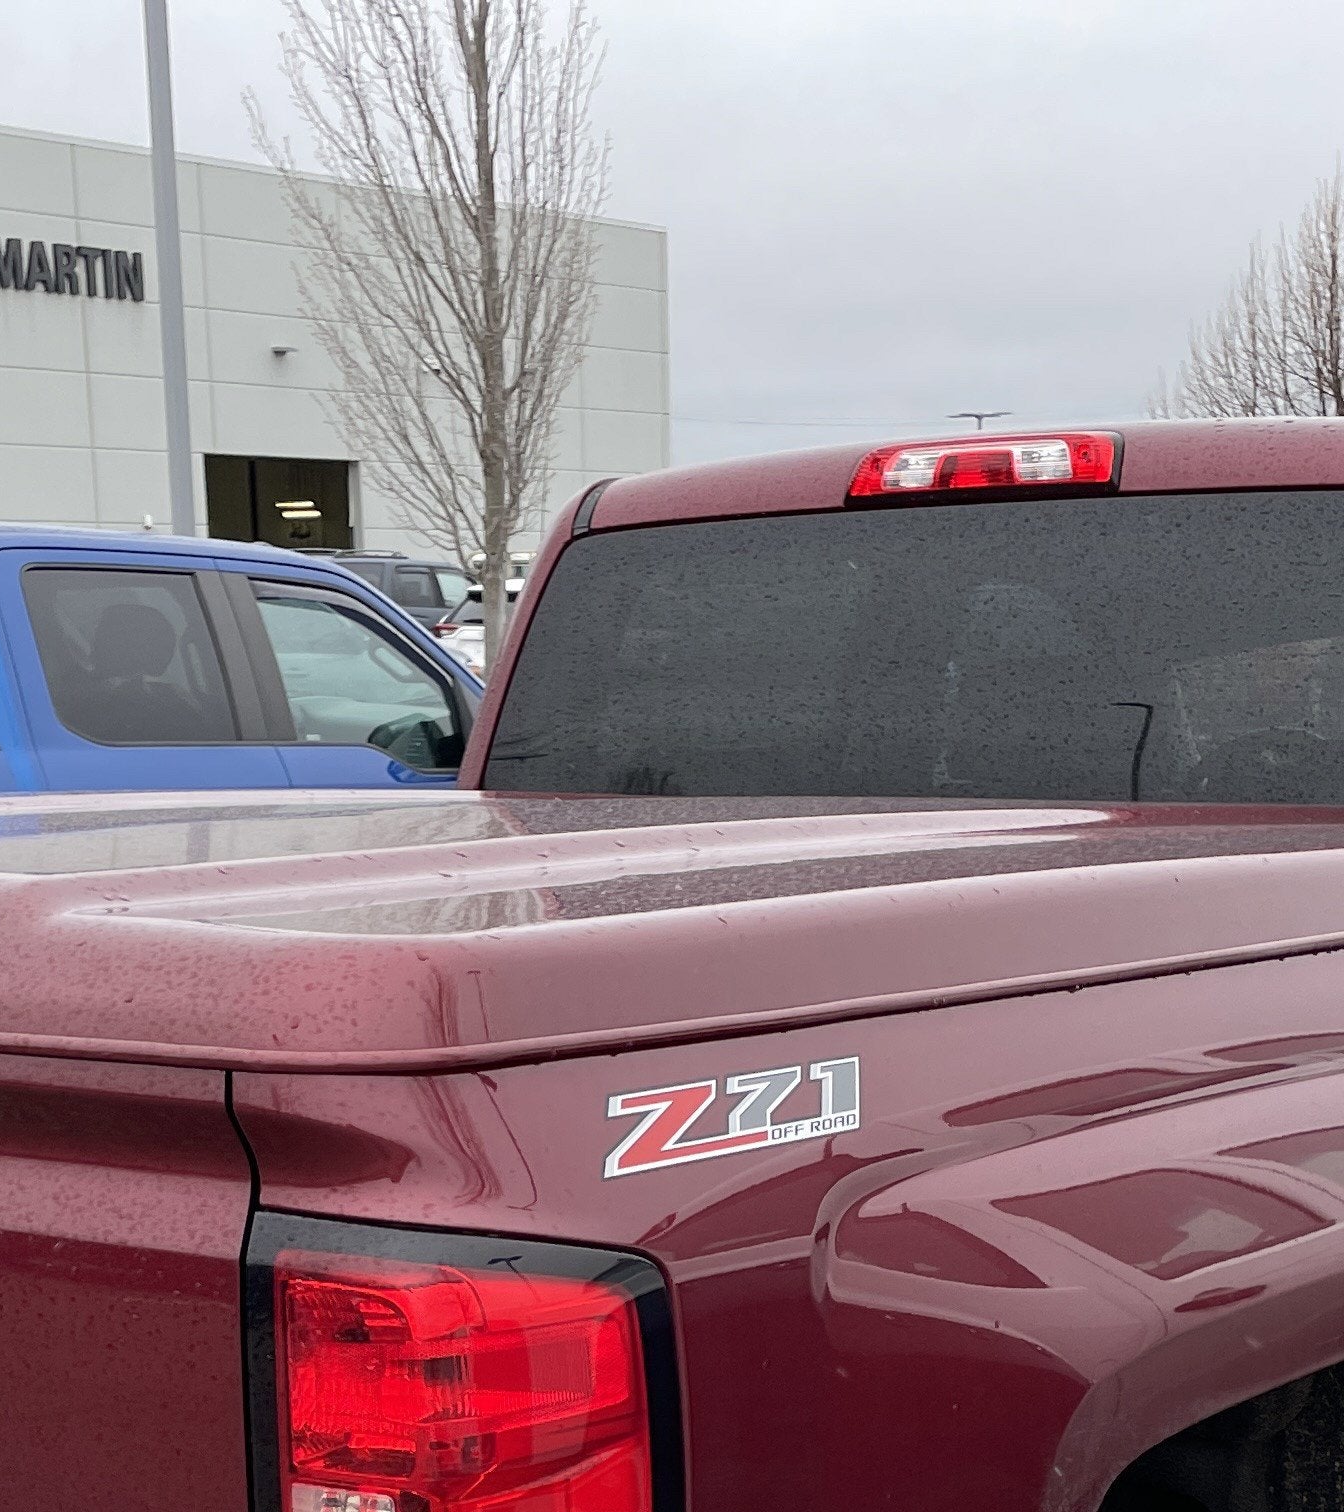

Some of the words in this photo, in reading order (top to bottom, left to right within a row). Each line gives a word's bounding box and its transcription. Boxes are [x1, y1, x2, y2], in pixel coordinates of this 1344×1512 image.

[603, 1056, 860, 1179] Z71
[771, 1124, 804, 1141] OFF
[810, 1113, 857, 1134] ROAD
